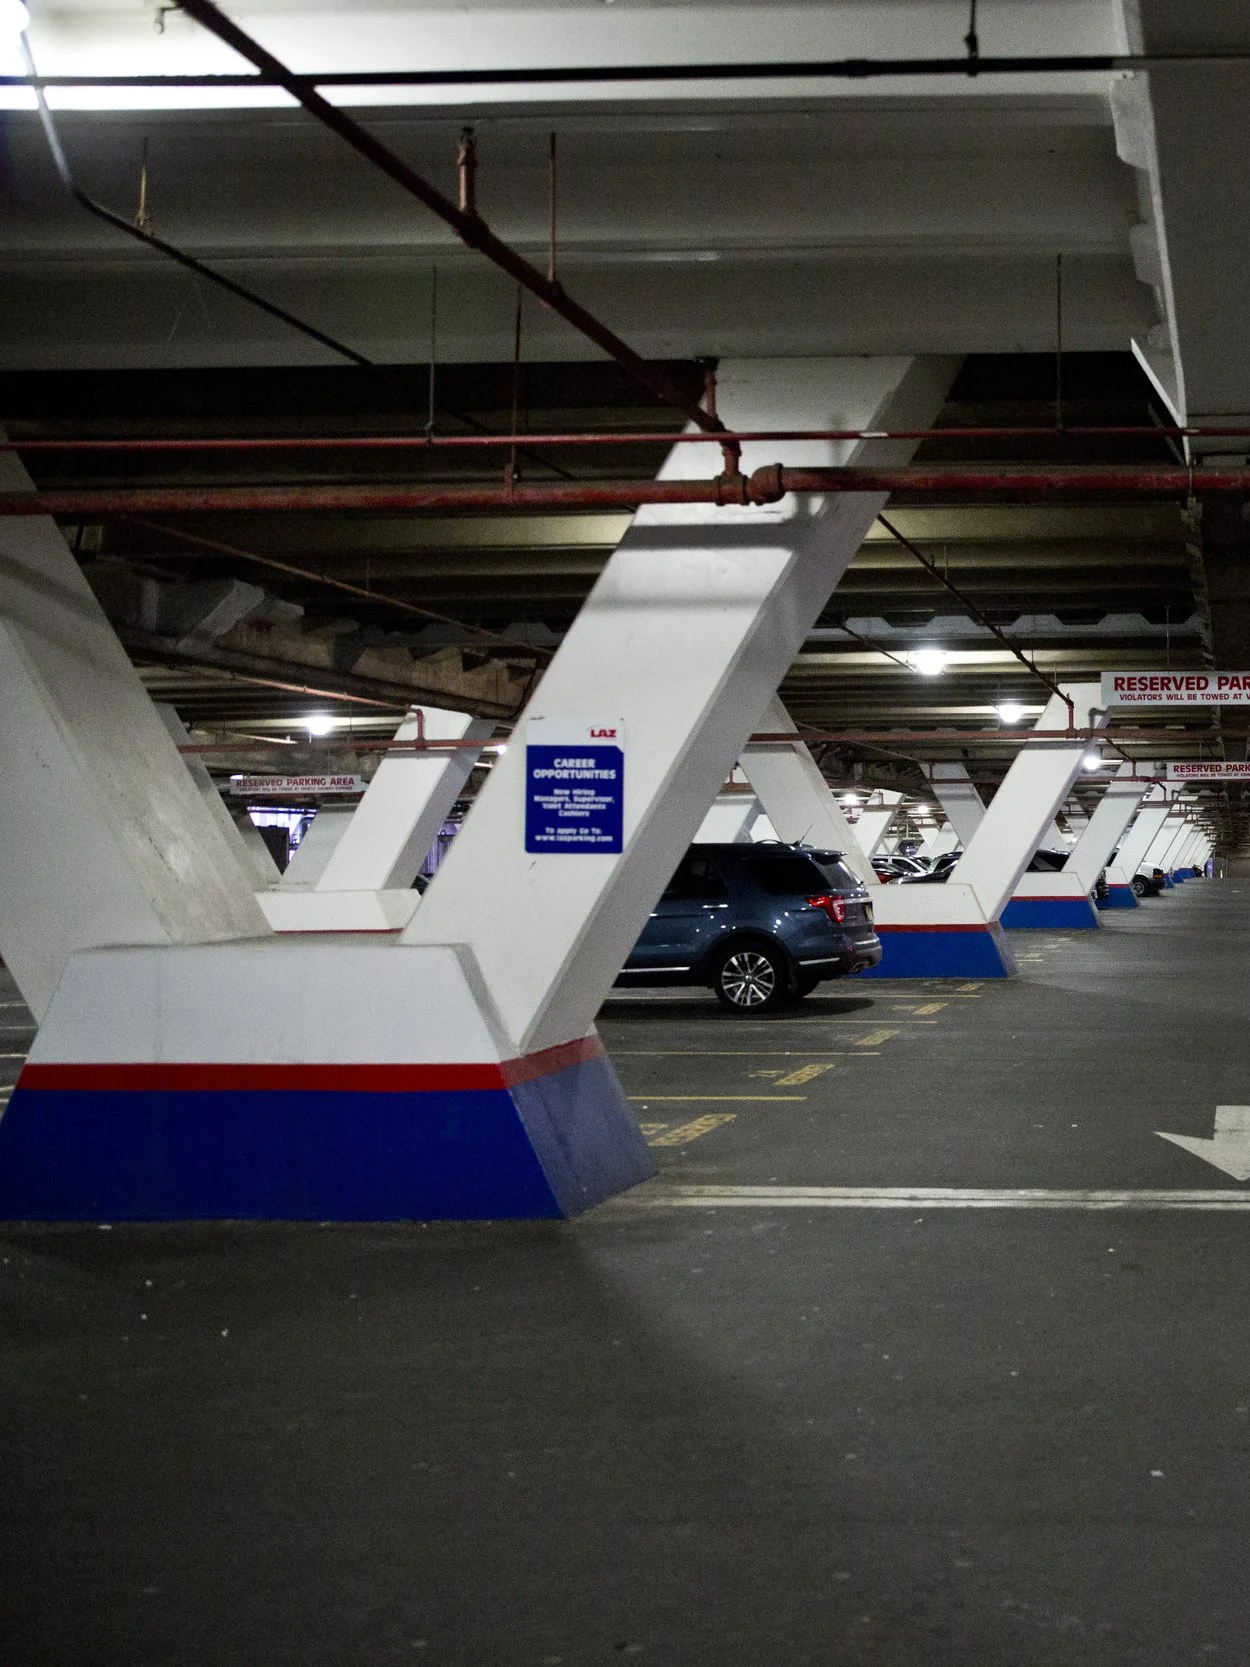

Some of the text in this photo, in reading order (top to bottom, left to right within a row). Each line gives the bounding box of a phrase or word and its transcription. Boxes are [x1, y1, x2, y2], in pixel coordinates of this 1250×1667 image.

[1114, 675, 1209, 691] RESERVED
[590, 729, 617, 738] LAZ
[554, 759, 595, 768] CAREER
[533, 769, 616, 779] OPPORTUNITIES
[236, 779, 283, 787] RESERVED
[287, 778, 326, 786] PARKING
